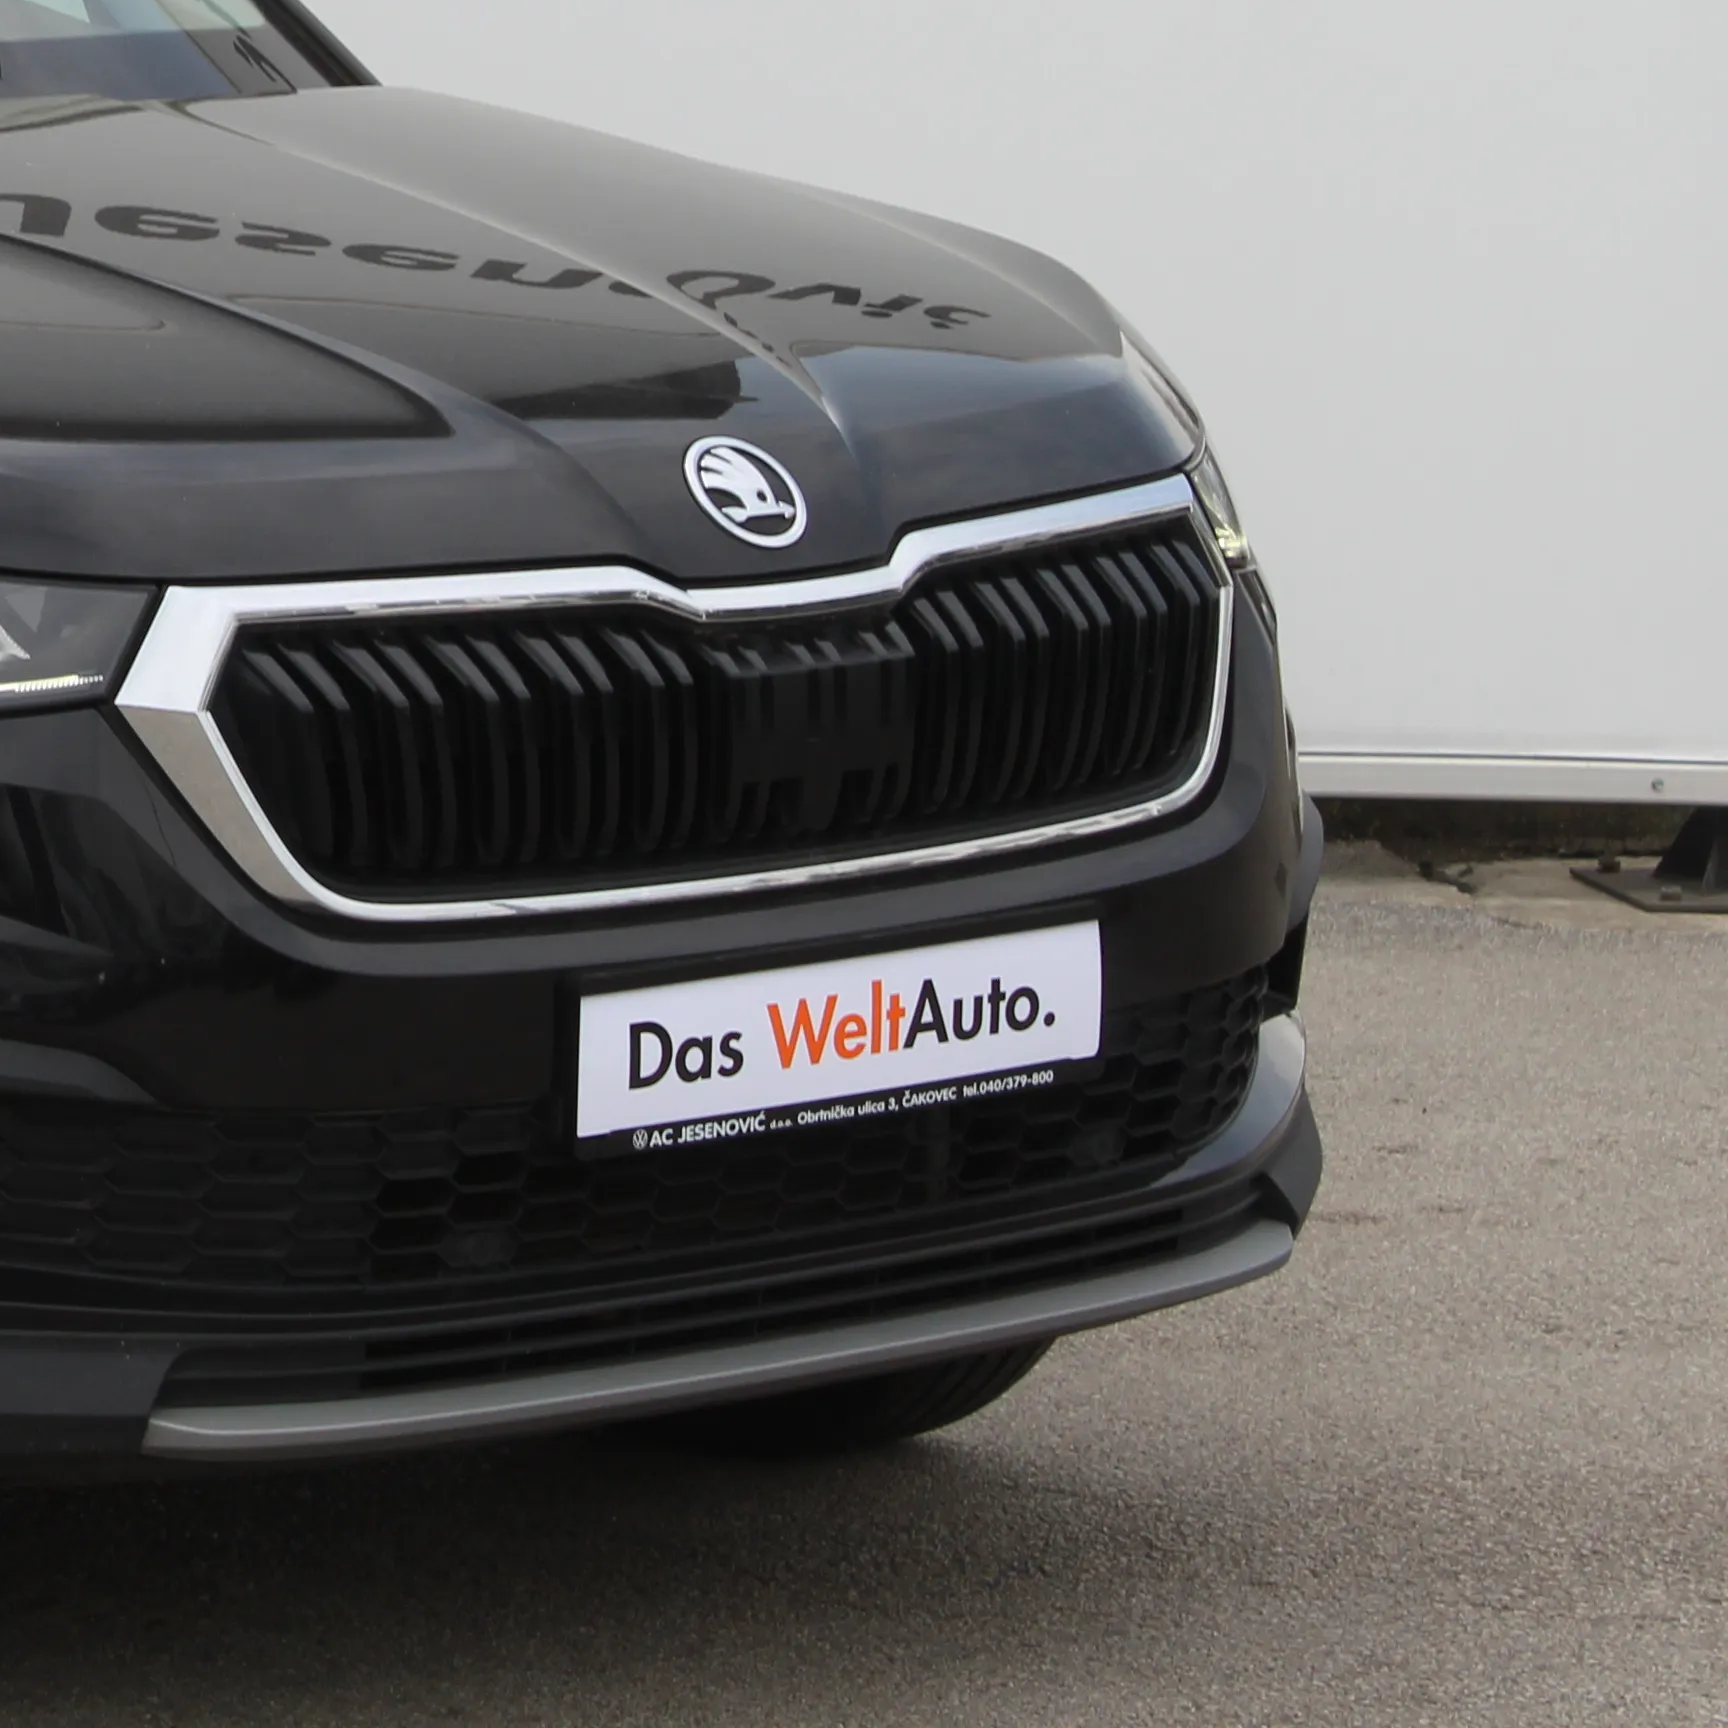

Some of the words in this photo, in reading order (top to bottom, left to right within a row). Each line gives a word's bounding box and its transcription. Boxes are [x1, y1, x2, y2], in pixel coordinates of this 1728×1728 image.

[628, 1020, 743, 1090] Das
[767, 978, 1056, 1069] WeltAuto.
[649, 1129, 673, 1148] AC
[678, 1110, 766, 1143] JESENOVIĆ
[797, 1104, 855, 1125] Obrtnička
[858, 1100, 885, 1115] ulica
[888, 1096, 899, 1111] 3,
[902, 1087, 957, 1108] ČAKOVEC
